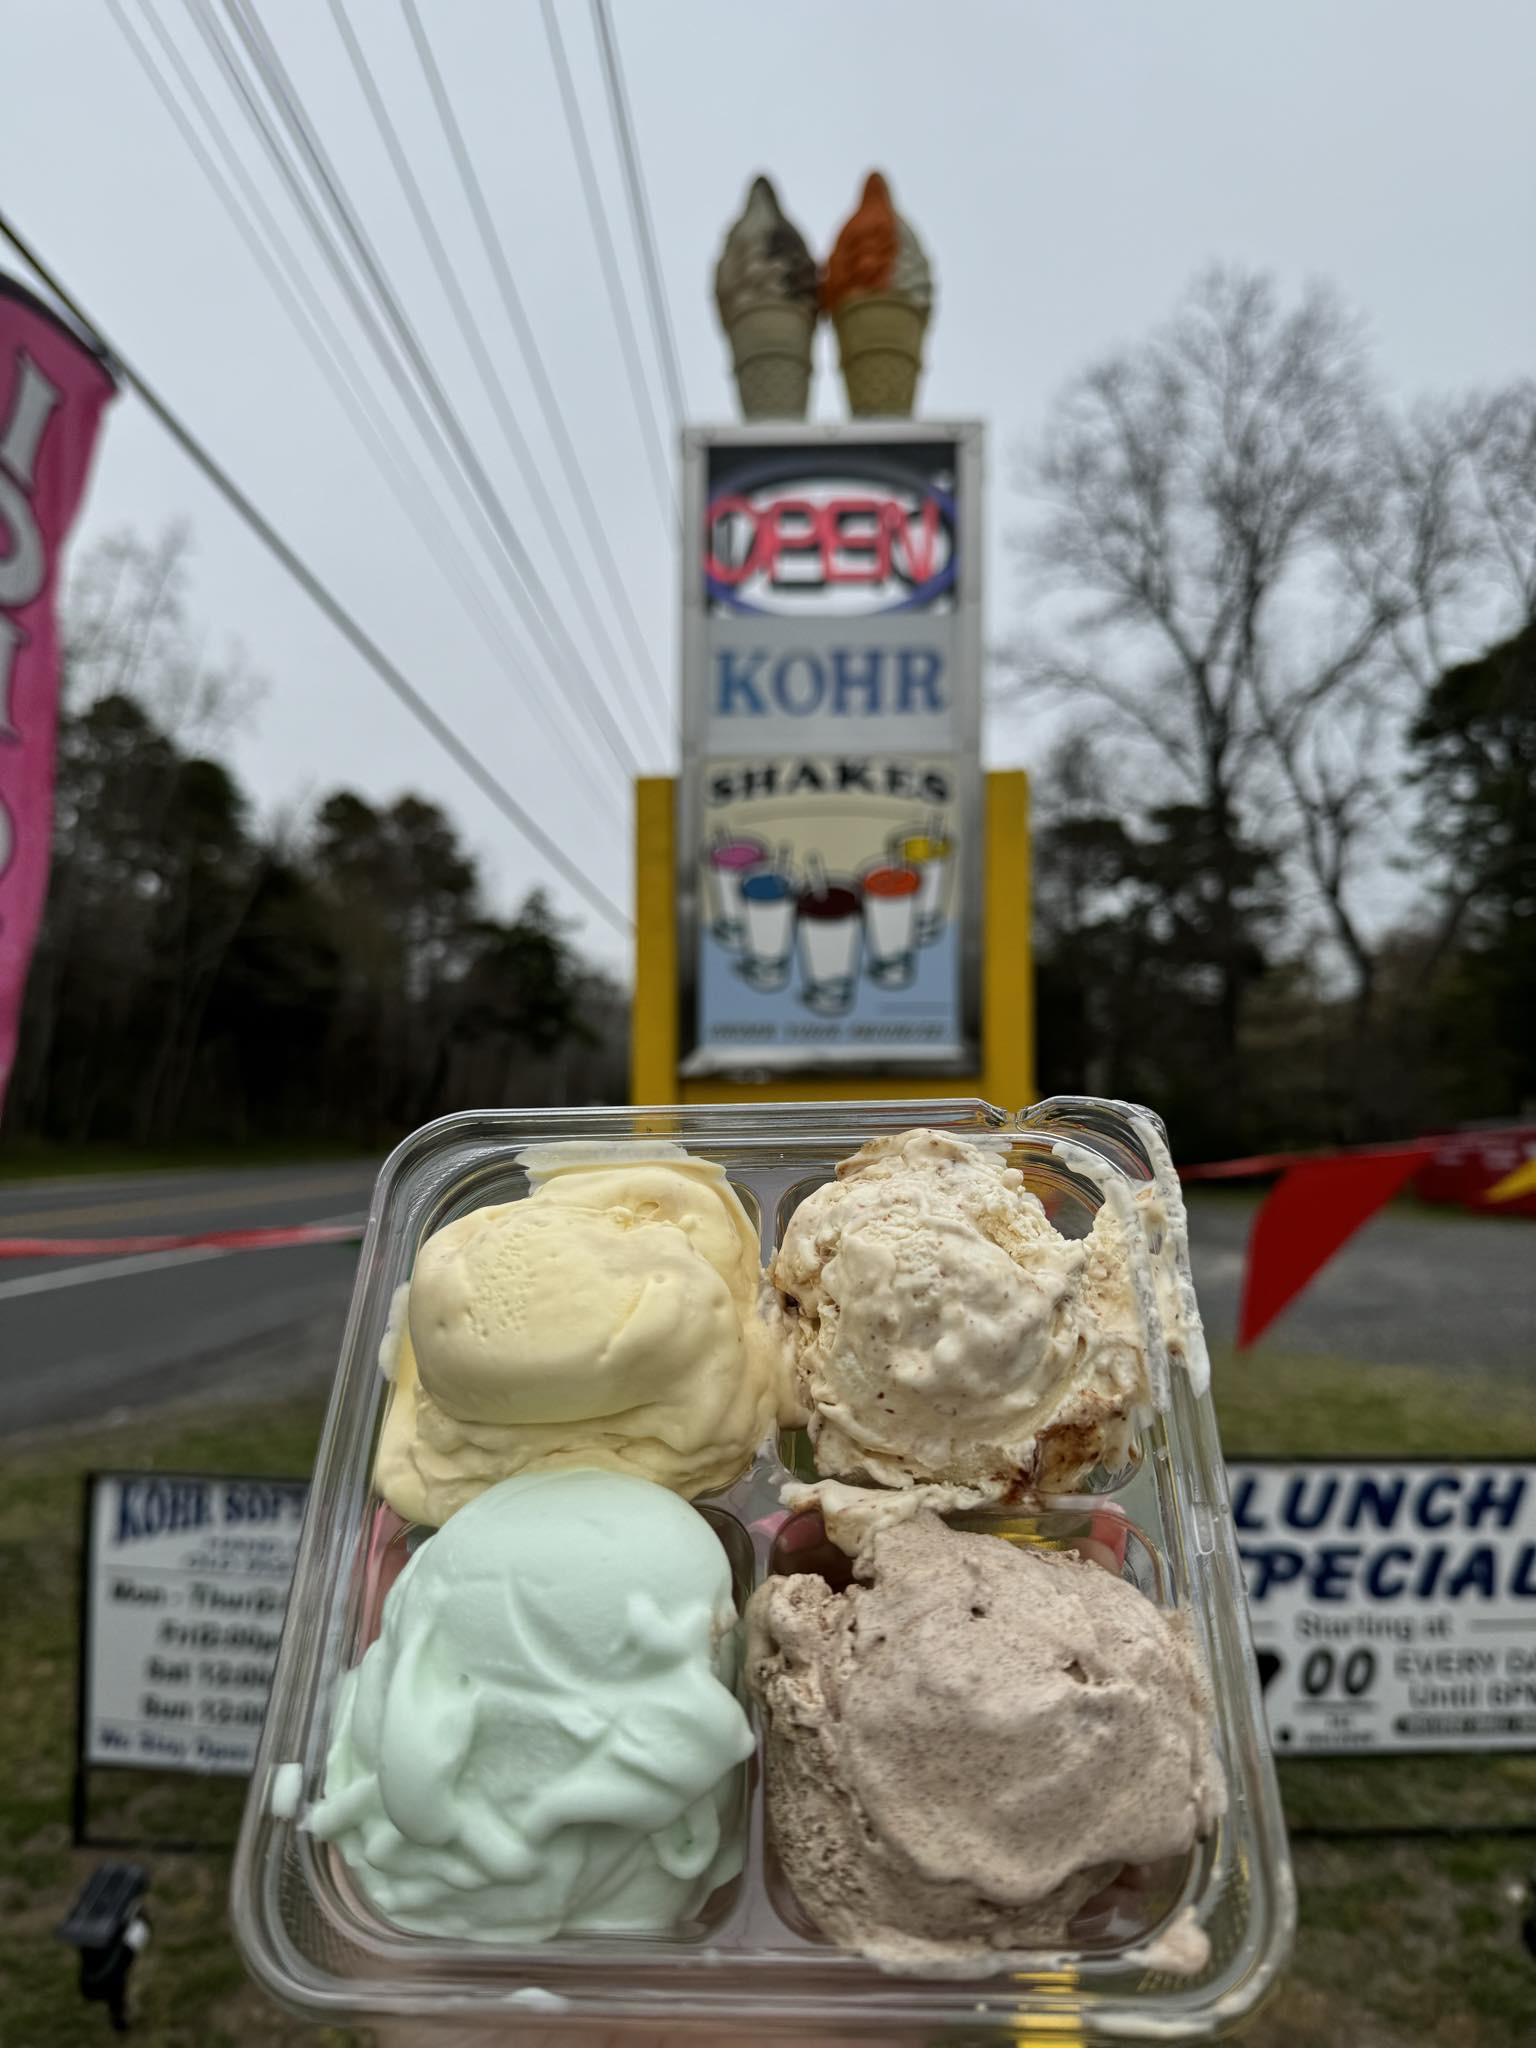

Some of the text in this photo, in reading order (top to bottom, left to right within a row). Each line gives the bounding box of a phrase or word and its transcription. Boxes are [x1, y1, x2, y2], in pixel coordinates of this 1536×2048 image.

[704, 493, 942, 588] OPEN
[715, 647, 945, 716] KOHR
[712, 758, 950, 802] SHAKES
[1233, 1474, 1527, 1531] LUNCH
[1240, 1543, 1536, 1602] PECIAL
[1297, 1612, 1413, 1642] Starting
[1394, 1649, 1497, 1677] EVERY
